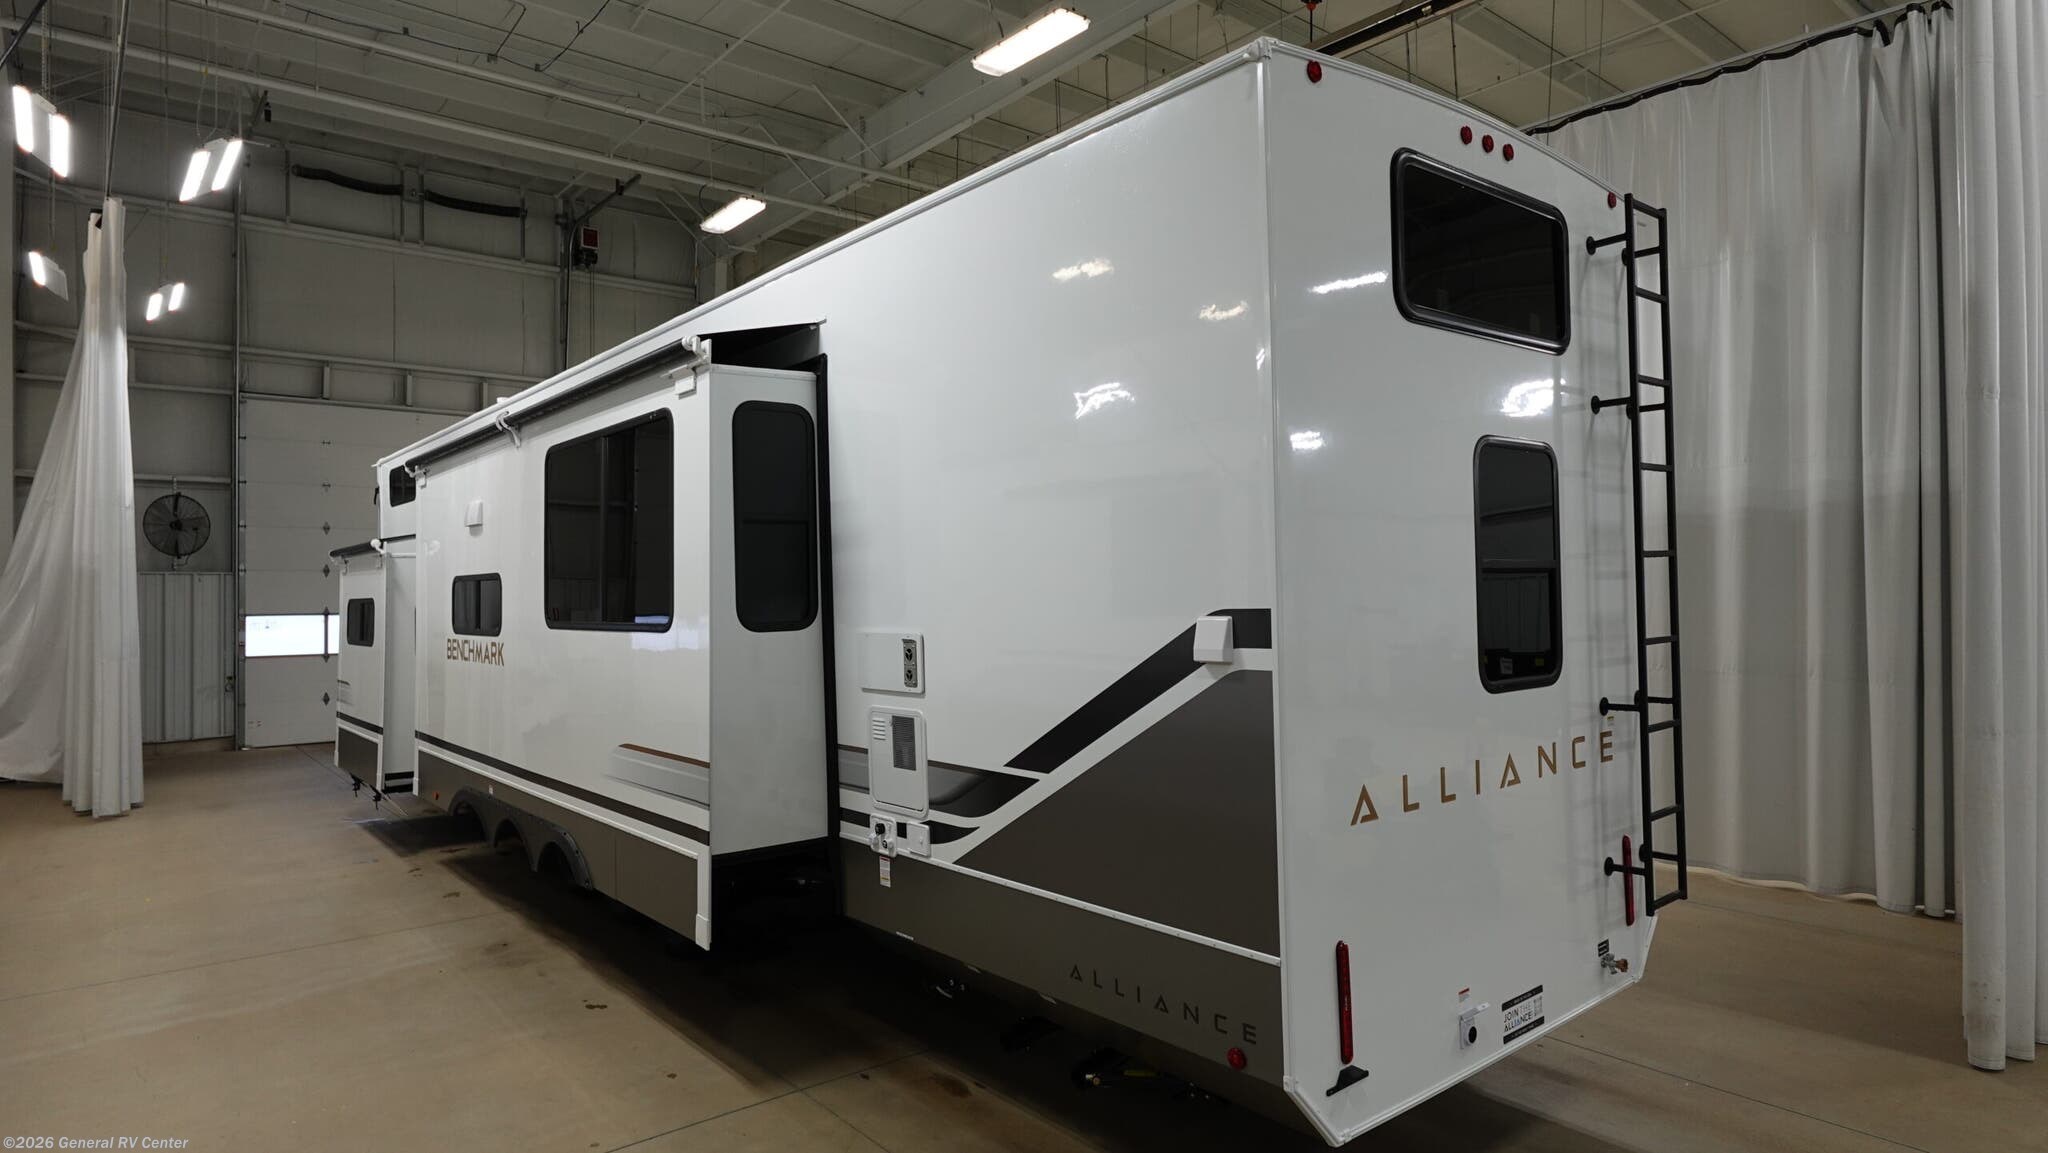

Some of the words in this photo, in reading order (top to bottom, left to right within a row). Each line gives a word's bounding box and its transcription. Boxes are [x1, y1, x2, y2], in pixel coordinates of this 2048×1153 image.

[447, 638, 504, 666] BENCHMARK
[1350, 730, 1614, 826] ALLIANCE
[1069, 964, 1257, 1045] ALLIANCE
[1503, 1007, 1519, 1023] JOIN
[1504, 1011, 1532, 1032] ALLIANCE
